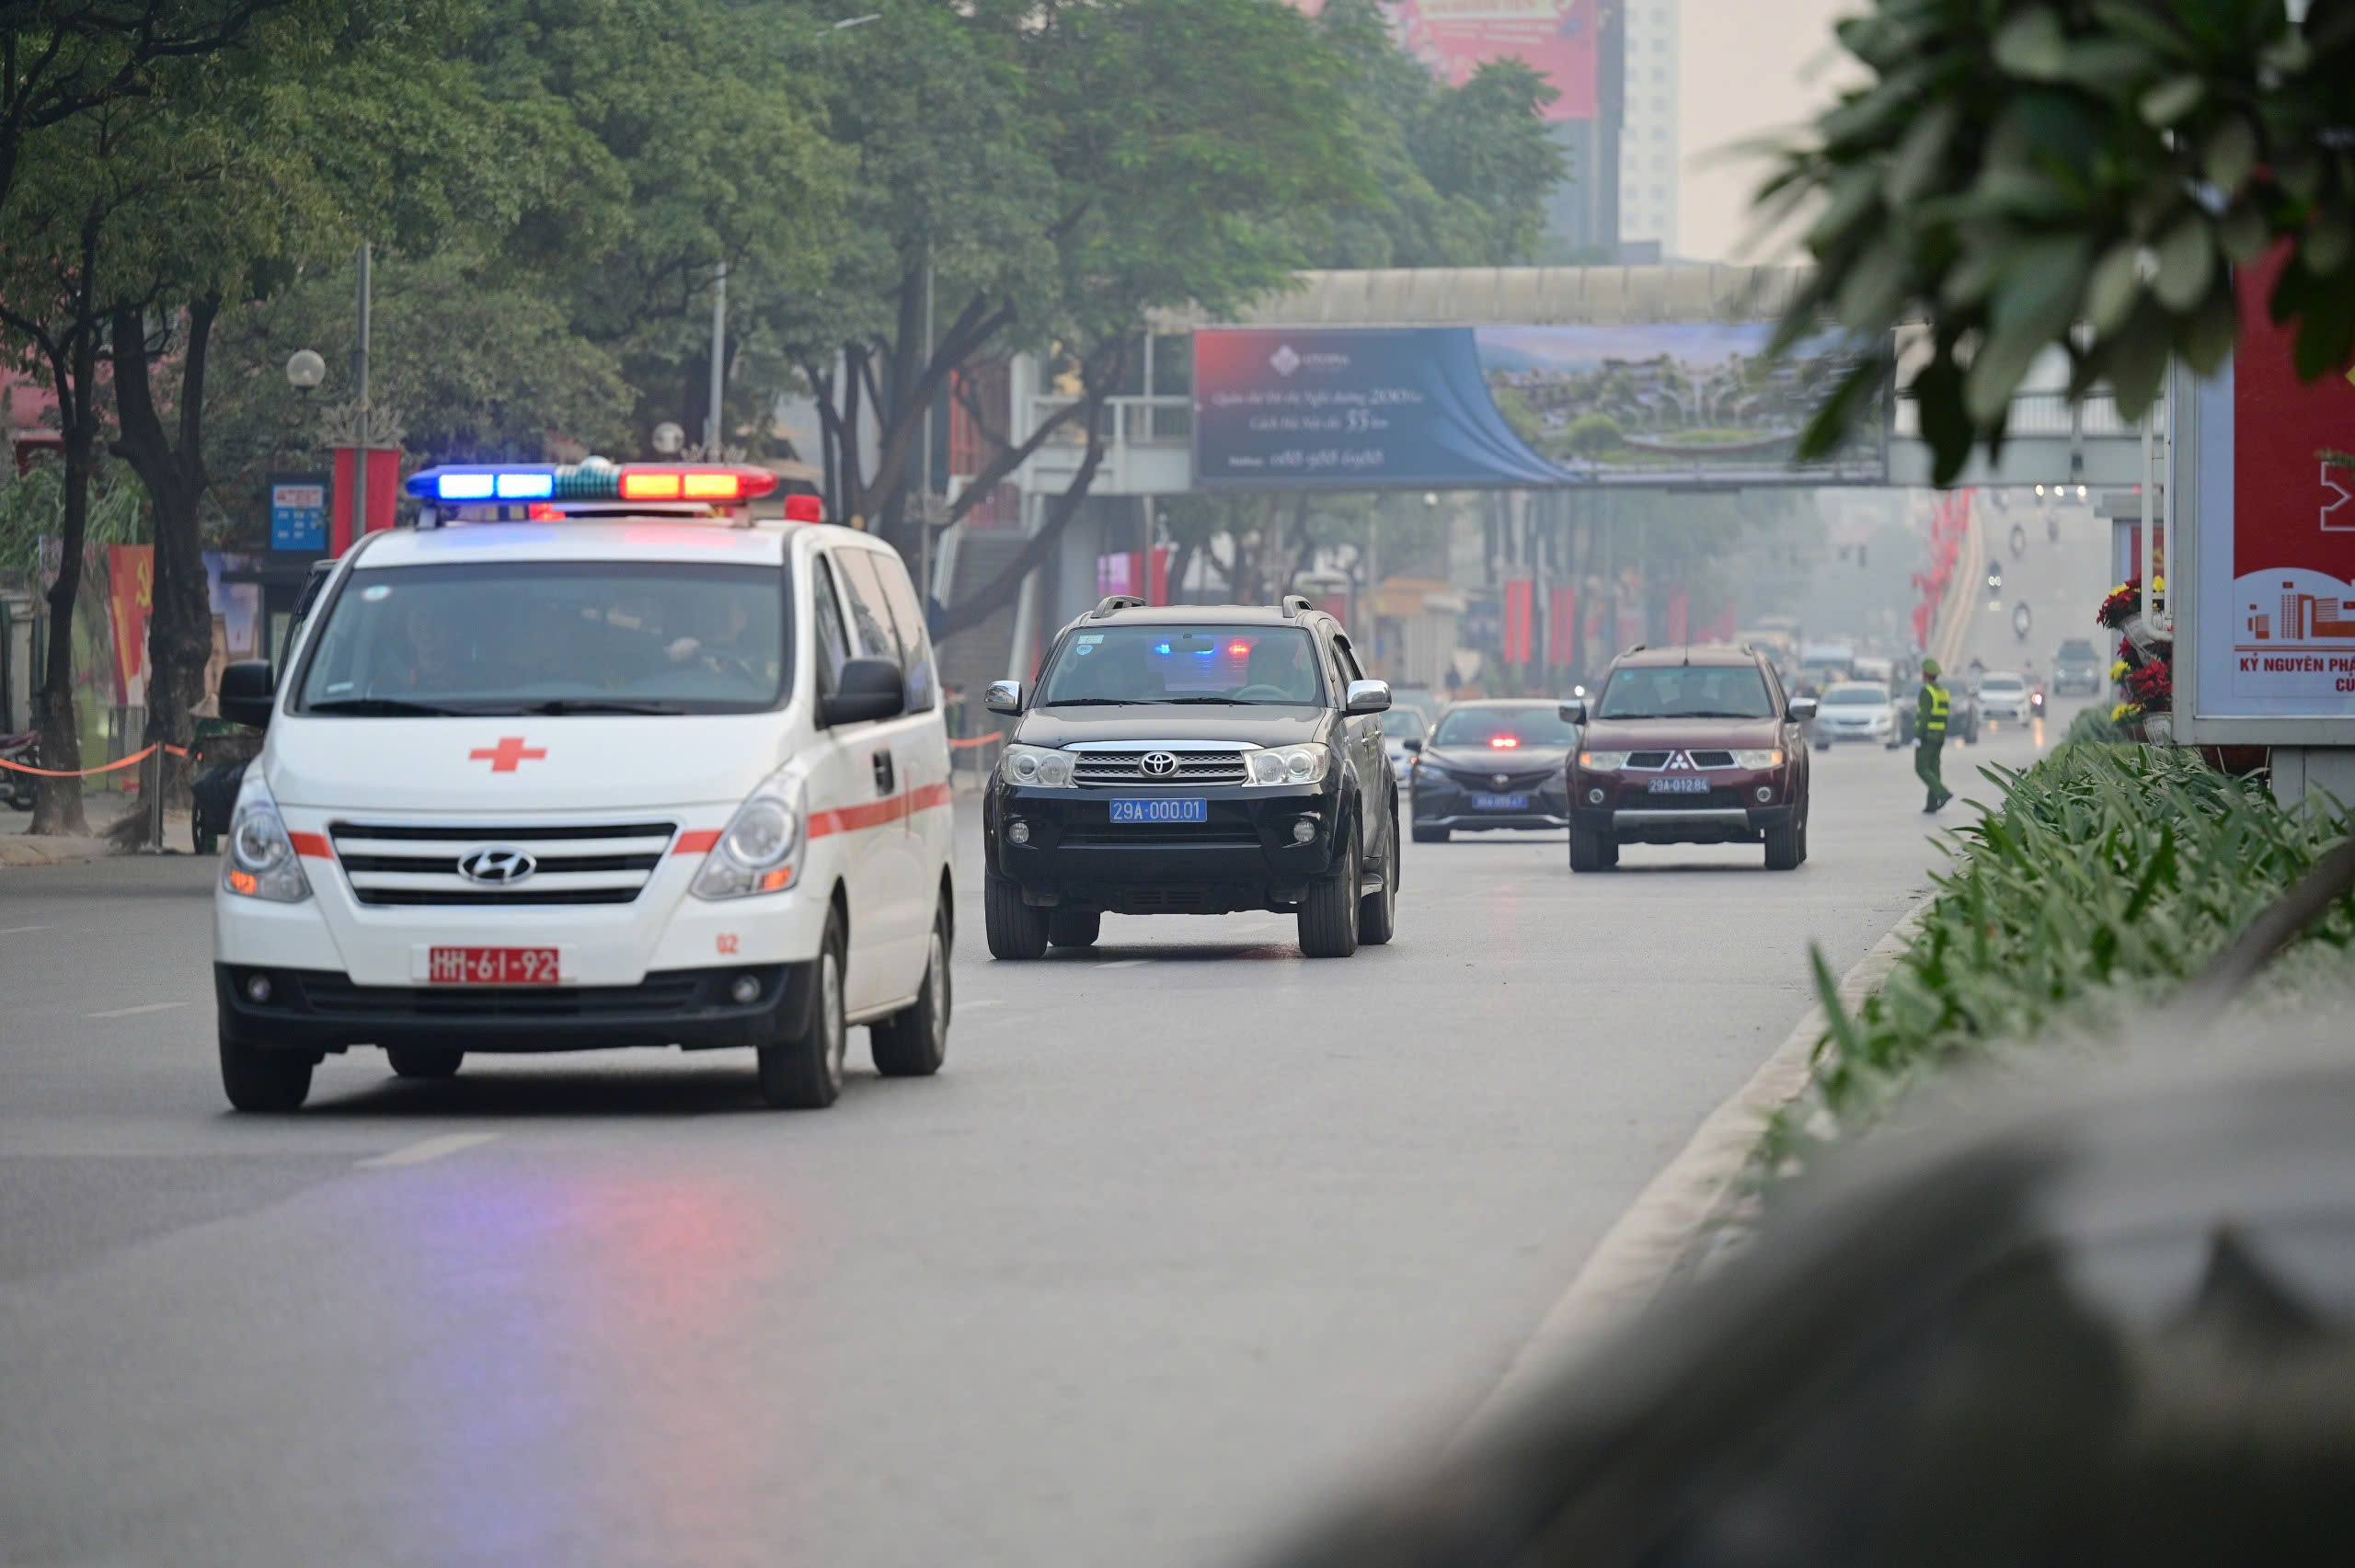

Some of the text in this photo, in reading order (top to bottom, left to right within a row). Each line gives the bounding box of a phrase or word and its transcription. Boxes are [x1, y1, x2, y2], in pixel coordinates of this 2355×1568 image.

[2239, 652, 2259, 671] KỶ
[2263, 655, 2325, 672] NGUYÊN
[1112, 800, 1201, 821] 29A-000.01
[716, 933, 740, 955] 02
[432, 947, 556, 981] HH-61-92
